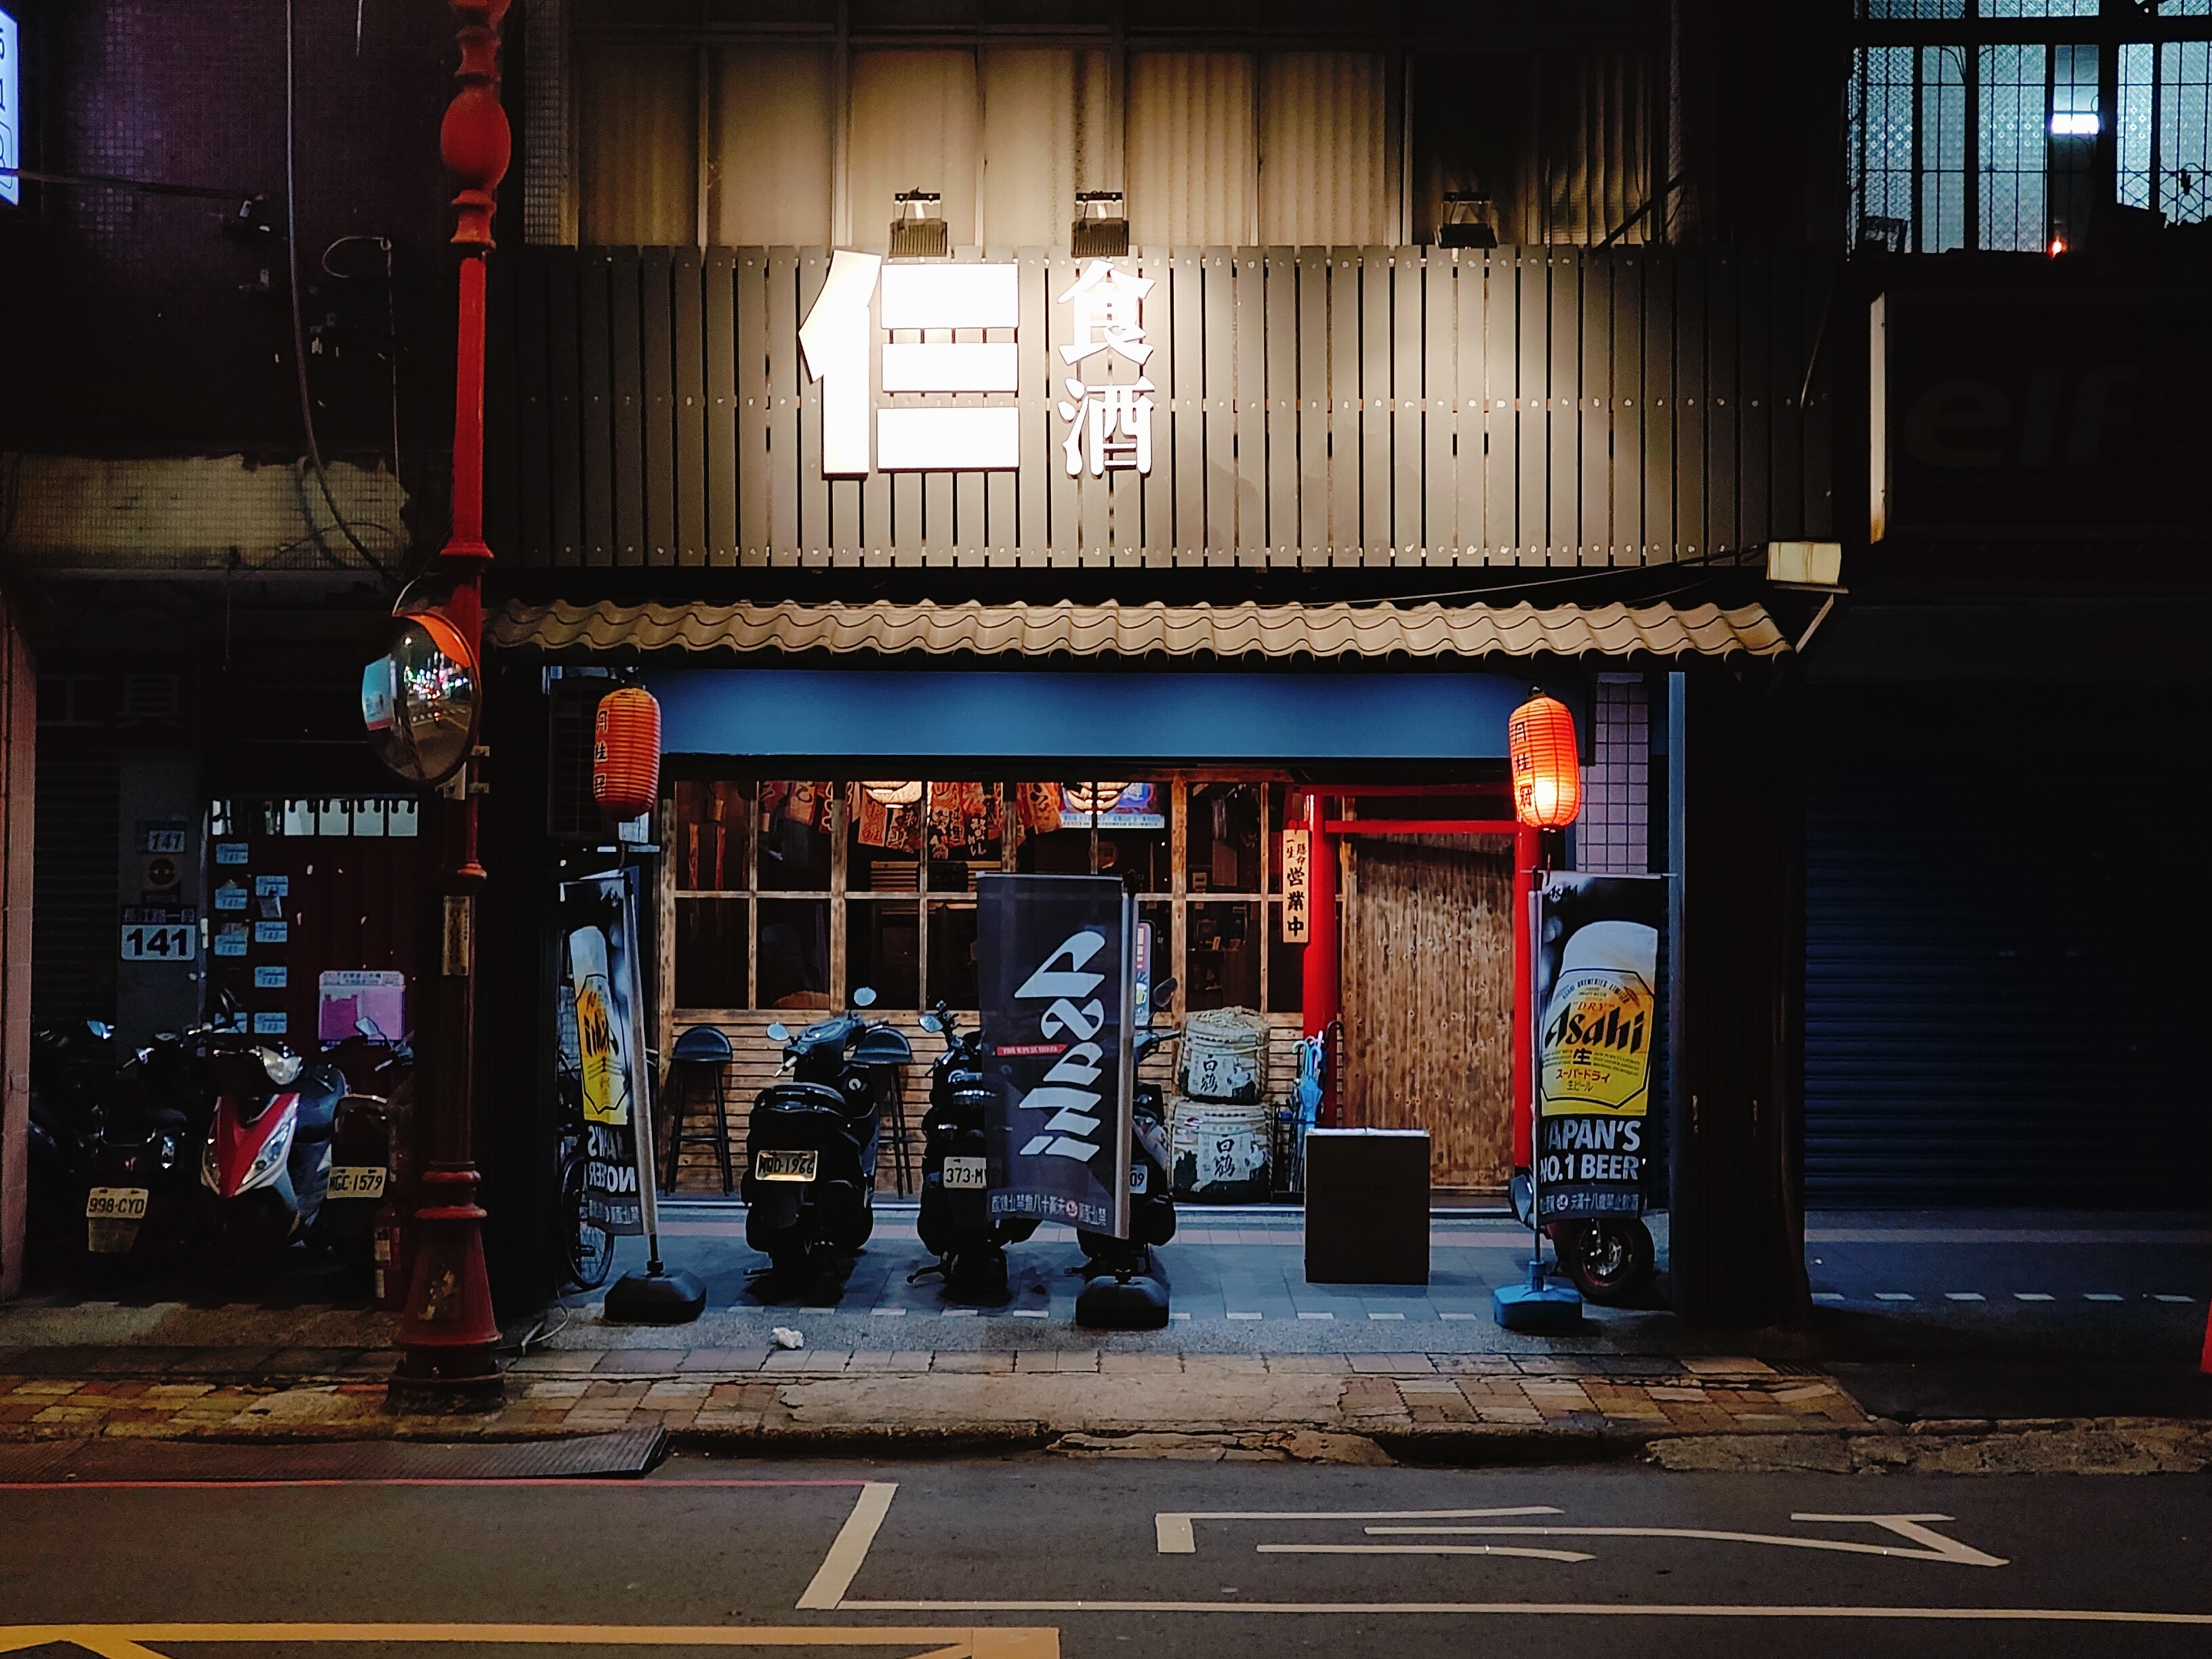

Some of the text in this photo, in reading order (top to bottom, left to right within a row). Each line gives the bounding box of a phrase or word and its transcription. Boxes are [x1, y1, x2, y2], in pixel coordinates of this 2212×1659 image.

[1057, 259, 1155, 476] 食酒
[1903, 365, 2141, 468] elf
[1515, 722, 1533, 807] 月桂冠
[1286, 866, 1305, 937] 営業中
[127, 928, 186, 956] 141
[1544, 1003, 1645, 1054] Asahi
[1201, 1054, 1218, 1092] 白鶴
[1556, 1067, 1610, 1084] スーパードライ
[1573, 1048, 1593, 1066] 生
[1567, 1081, 1594, 1092] 生ビール
[1214, 1134, 1235, 1177] 白鶴
[1581, 1153, 1639, 1181] BEER
